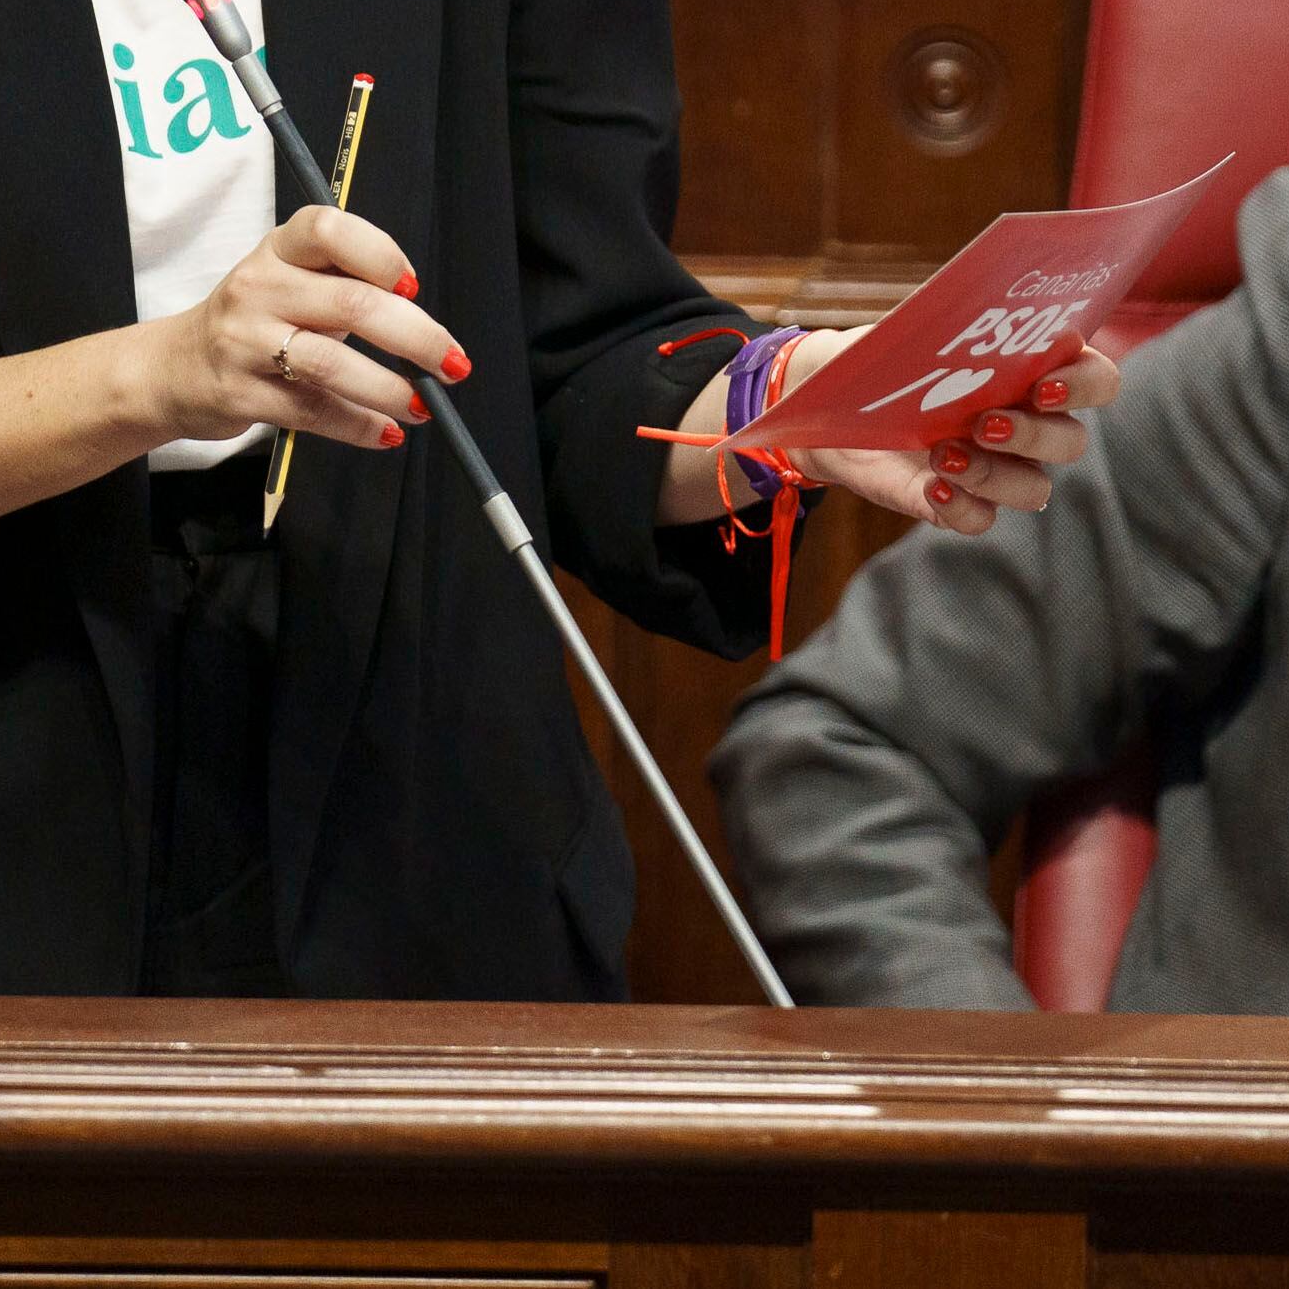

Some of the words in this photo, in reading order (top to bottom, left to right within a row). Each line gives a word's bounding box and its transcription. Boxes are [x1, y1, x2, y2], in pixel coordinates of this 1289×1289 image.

[113, 43, 267, 159] ia
[338, 148, 350, 171] Noris
[1006, 262, 1119, 299] Canarias
[935, 298, 1091, 356] PSOE
